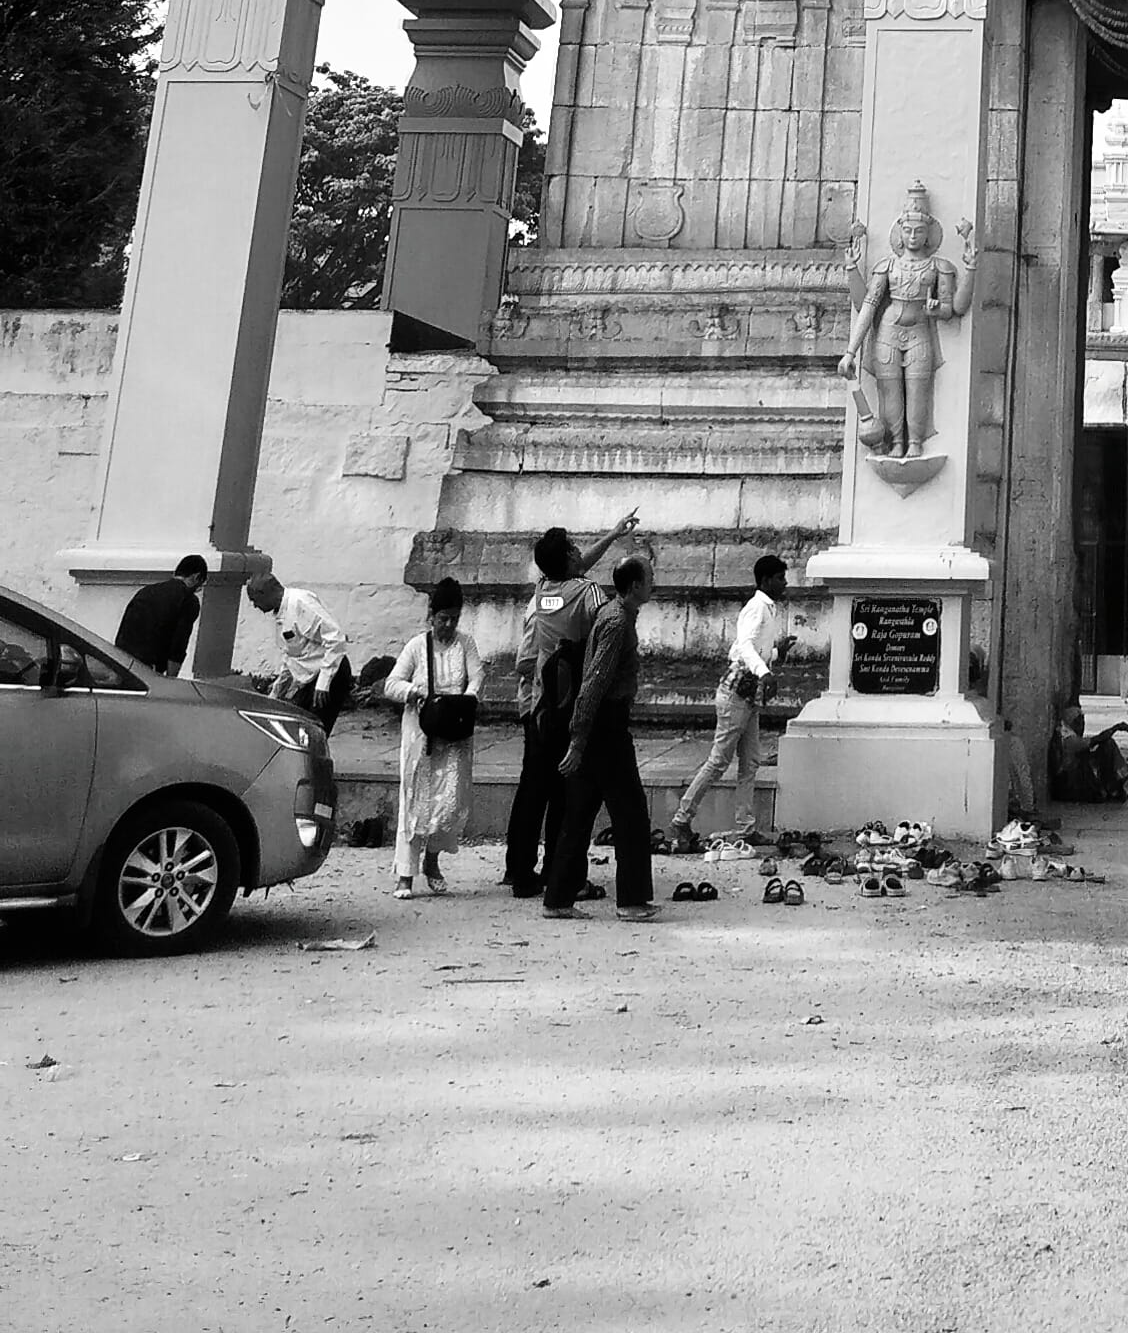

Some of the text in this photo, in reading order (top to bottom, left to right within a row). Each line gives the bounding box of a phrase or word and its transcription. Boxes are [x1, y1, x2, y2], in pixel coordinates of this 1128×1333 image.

[860, 604, 871, 614] Sri
[912, 604, 934, 616] Temple
[871, 629, 921, 642] Raja Gopuram
[855, 653, 863, 662] Sri
[919, 653, 936, 664] Reddy
